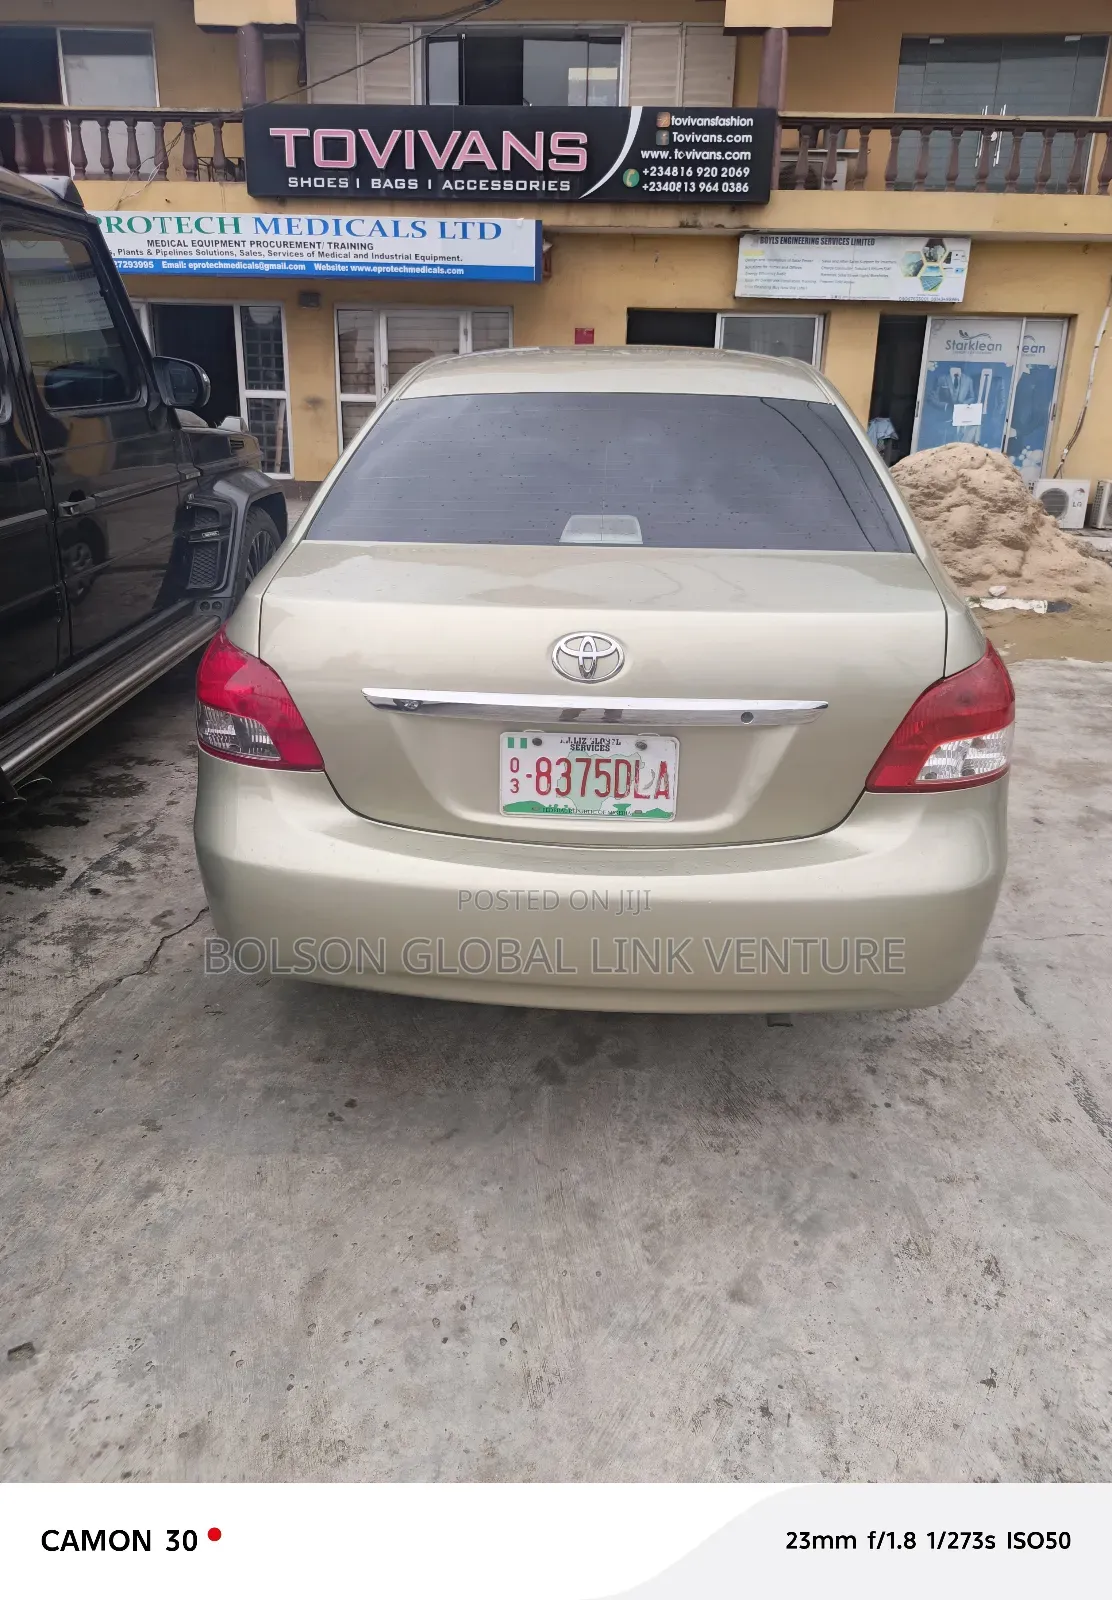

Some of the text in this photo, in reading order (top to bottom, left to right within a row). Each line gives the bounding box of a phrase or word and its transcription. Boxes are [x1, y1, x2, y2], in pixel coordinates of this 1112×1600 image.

[671, 115, 753, 127] tovivansfashion
[673, 132, 752, 143] Tovivans.com
[269, 127, 588, 172] TOVIVANS
[696, 167, 717, 178] 920
[721, 167, 750, 178] 2069
[288, 177, 349, 189] SHOES
[371, 178, 419, 190] BAGS
[442, 179, 571, 191] ACCESSORIES
[699, 182, 719, 193] 964
[721, 182, 749, 193] 0386
[253, 217, 427, 239] MEDICALS
[438, 220, 502, 240] LTD
[147, 239, 188, 248] MEDICAL
[191, 240, 246, 248] EQUIPMENT
[327, 242, 374, 251] TRAINING
[780, 237, 819, 245] ENGINEERING
[820, 237, 850, 246] SERVICES
[851, 238, 876, 246] LIMITED
[155, 249, 193, 257] Pipelines
[268, 250, 304, 258] Services
[307, 250, 315, 258] of
[318, 251, 351, 259] Medical
[414, 254, 463, 262] Equipment.
[162, 261, 187, 269] Email:
[188, 261, 306, 271] eprotechmedicals@gmail.com
[314, 263, 348, 271] Website:
[350, 264, 464, 275] www.eprotechmedicals.com
[945, 340, 1002, 351] Starklean
[570, 744, 610, 752] SERVICES
